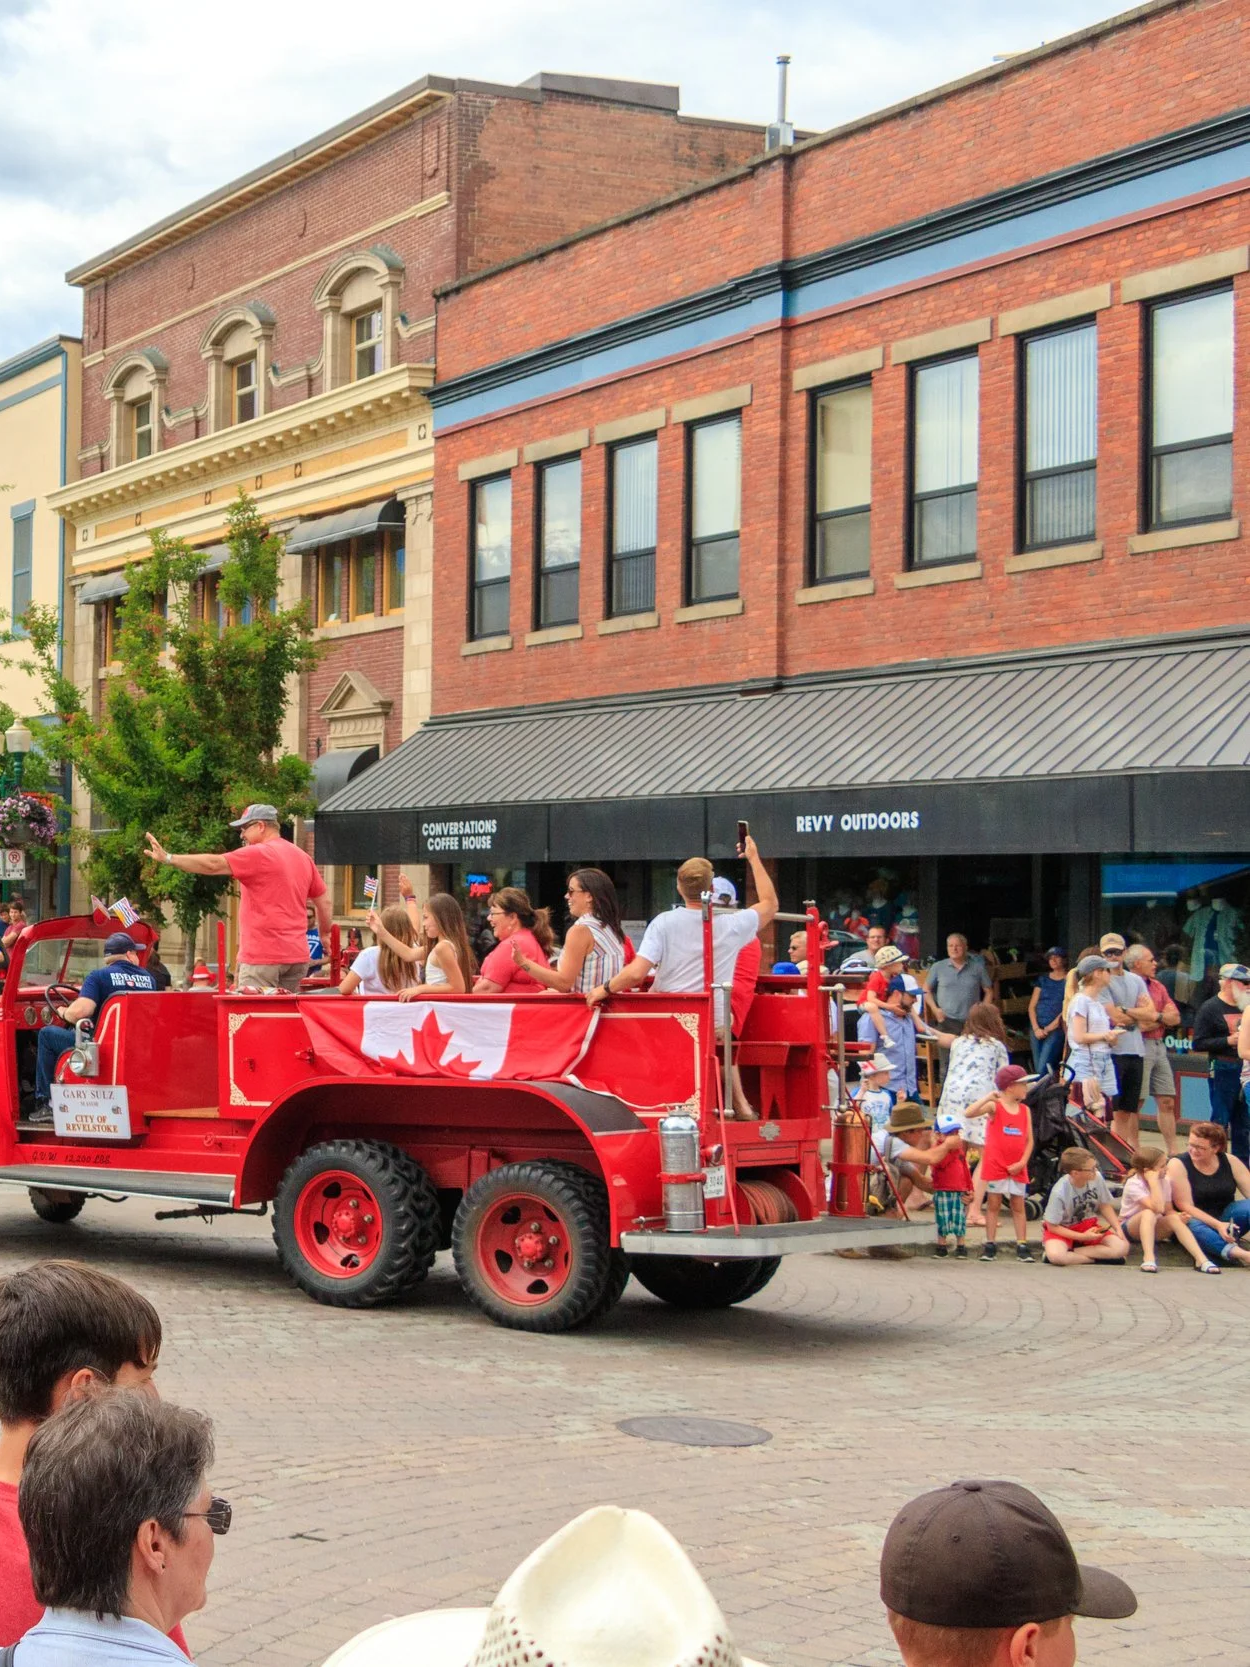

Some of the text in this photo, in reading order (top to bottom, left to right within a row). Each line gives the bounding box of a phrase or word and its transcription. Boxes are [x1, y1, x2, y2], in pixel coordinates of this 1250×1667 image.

[422, 819, 497, 836] CONVERSATIONS
[796, 811, 919, 832] REVY OUTDOORS
[427, 835, 492, 851] COFFEE HOUSE
[62, 1089, 115, 1100] GARY SULZ
[75, 1114, 108, 1123] CITY OF
[65, 1122, 119, 1133] REVELSTOKE
